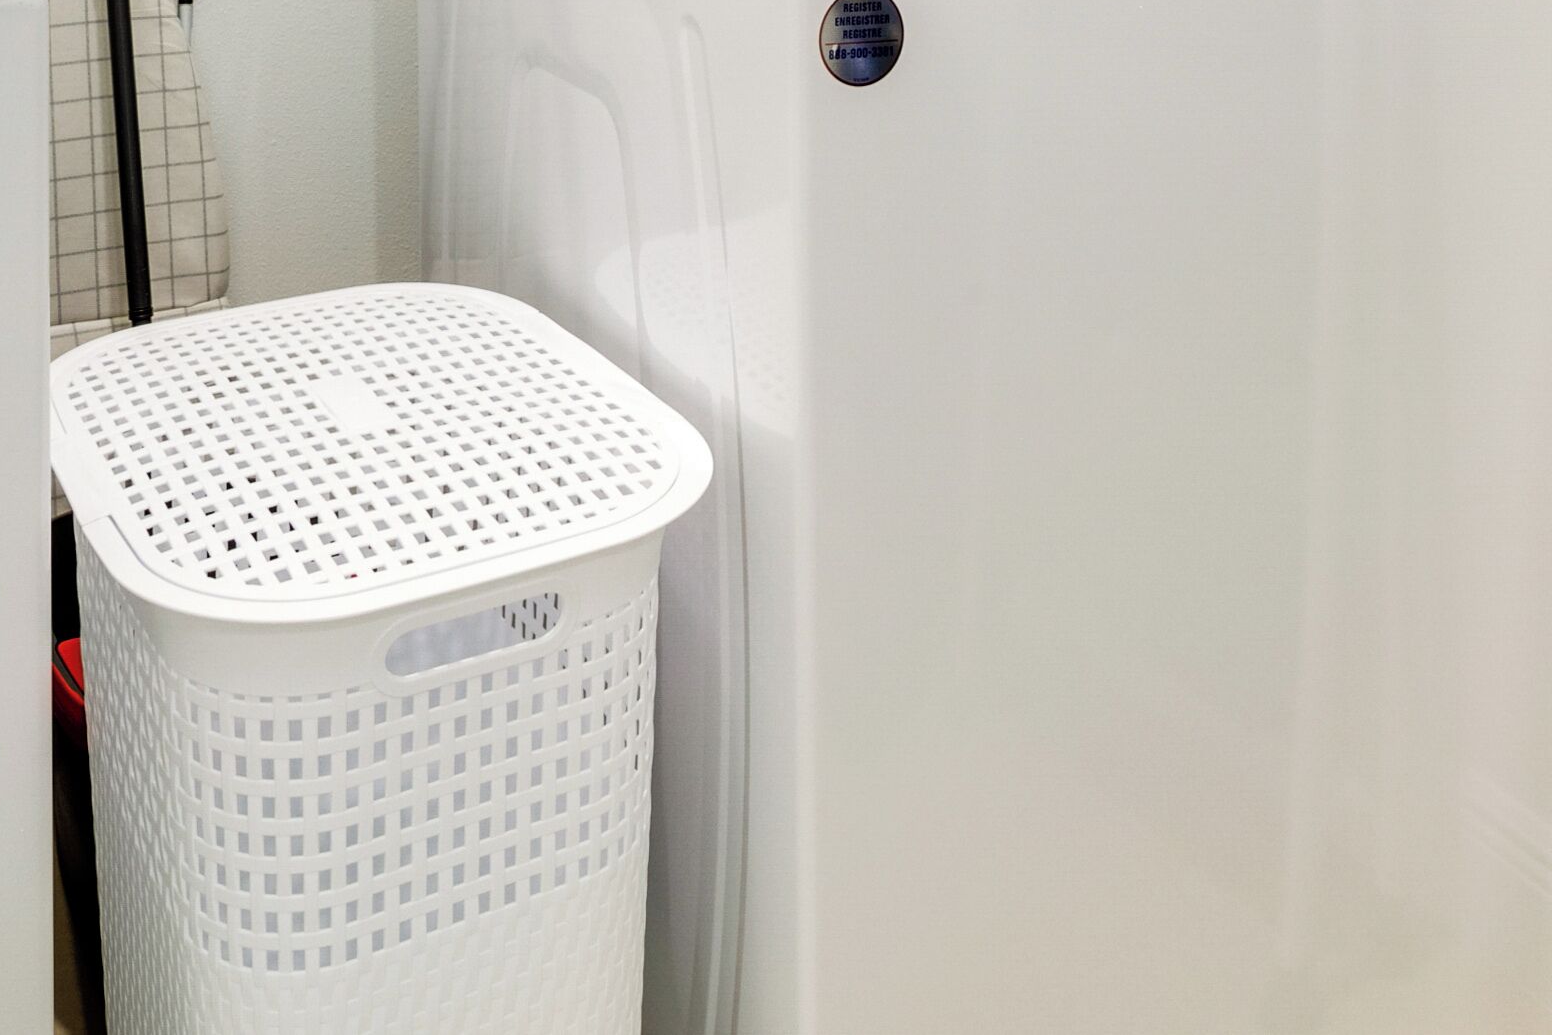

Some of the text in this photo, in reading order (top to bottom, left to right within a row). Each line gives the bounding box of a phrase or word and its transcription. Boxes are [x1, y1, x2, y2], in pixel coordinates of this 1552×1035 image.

[843, 1, 882, 13] REGISTER
[834, 14, 890, 26] ENREGISTRER
[843, 27, 882, 39] REGISTRE
